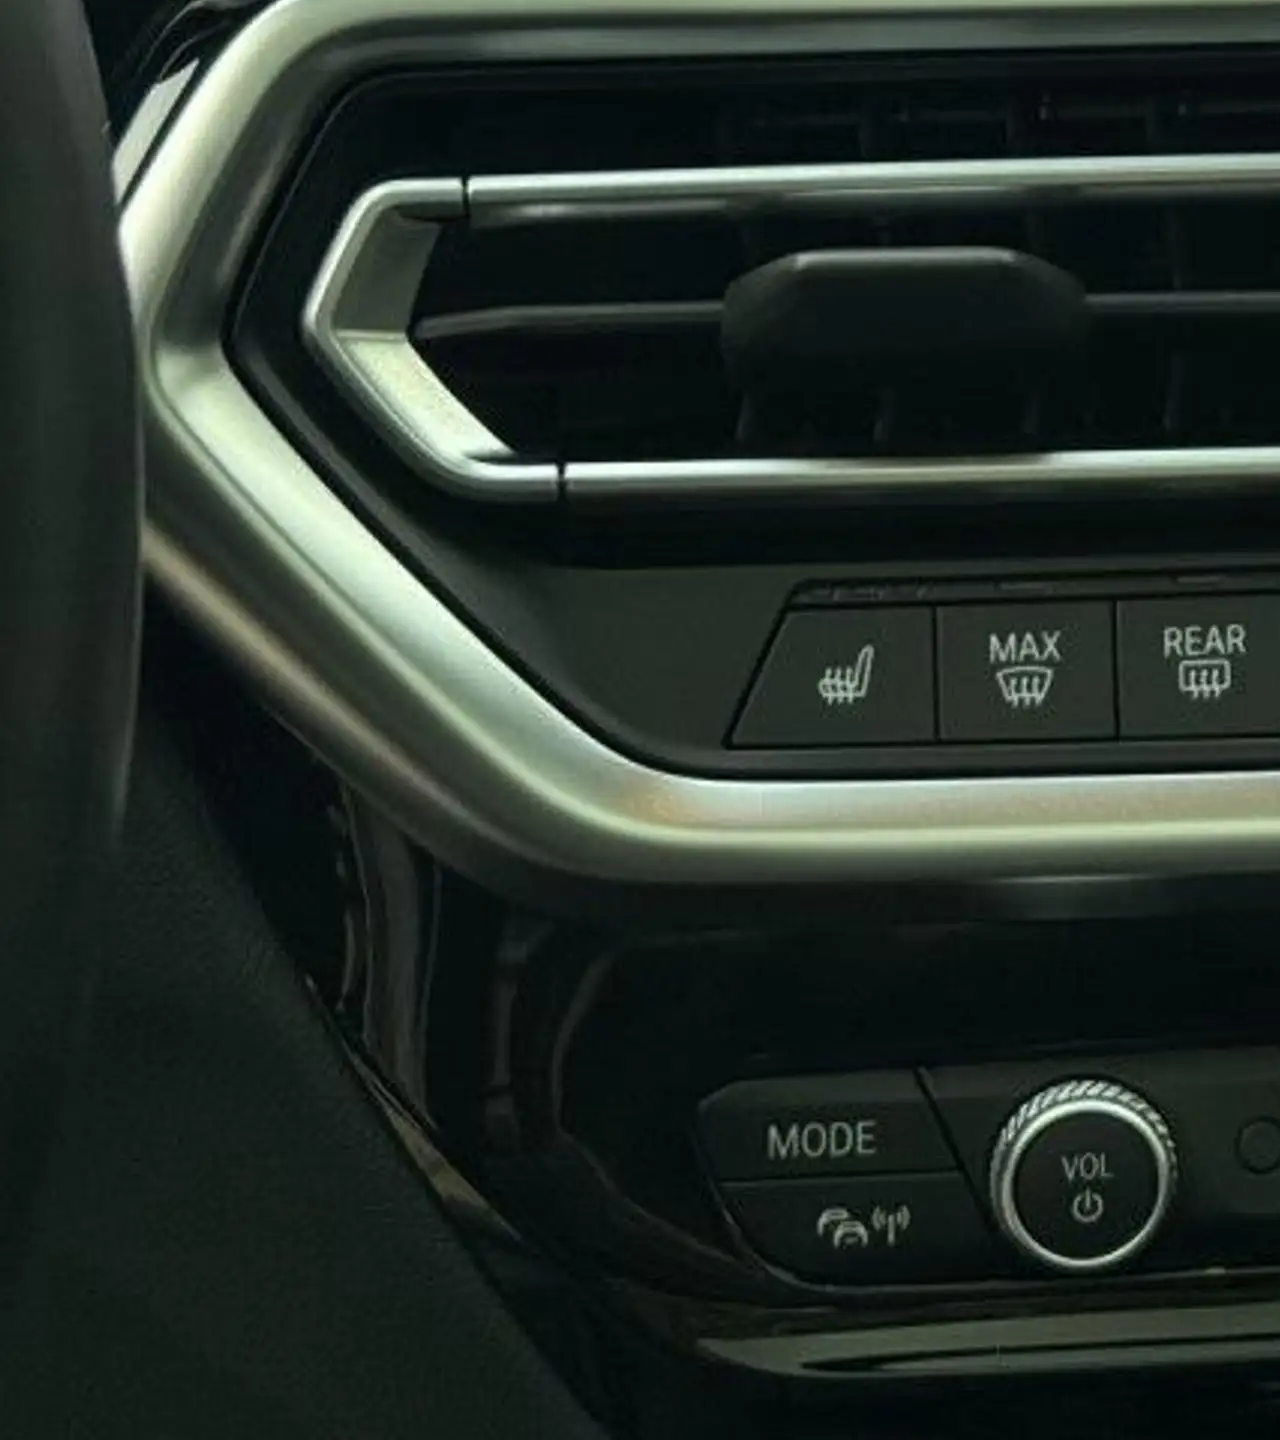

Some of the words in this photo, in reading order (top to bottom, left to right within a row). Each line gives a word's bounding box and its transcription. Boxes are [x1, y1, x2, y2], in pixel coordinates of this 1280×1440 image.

[988, 630, 1063, 663] MAX
[1162, 625, 1247, 659] REAR
[767, 1120, 877, 1160] MODE
[1060, 1152, 1114, 1182] VOL
